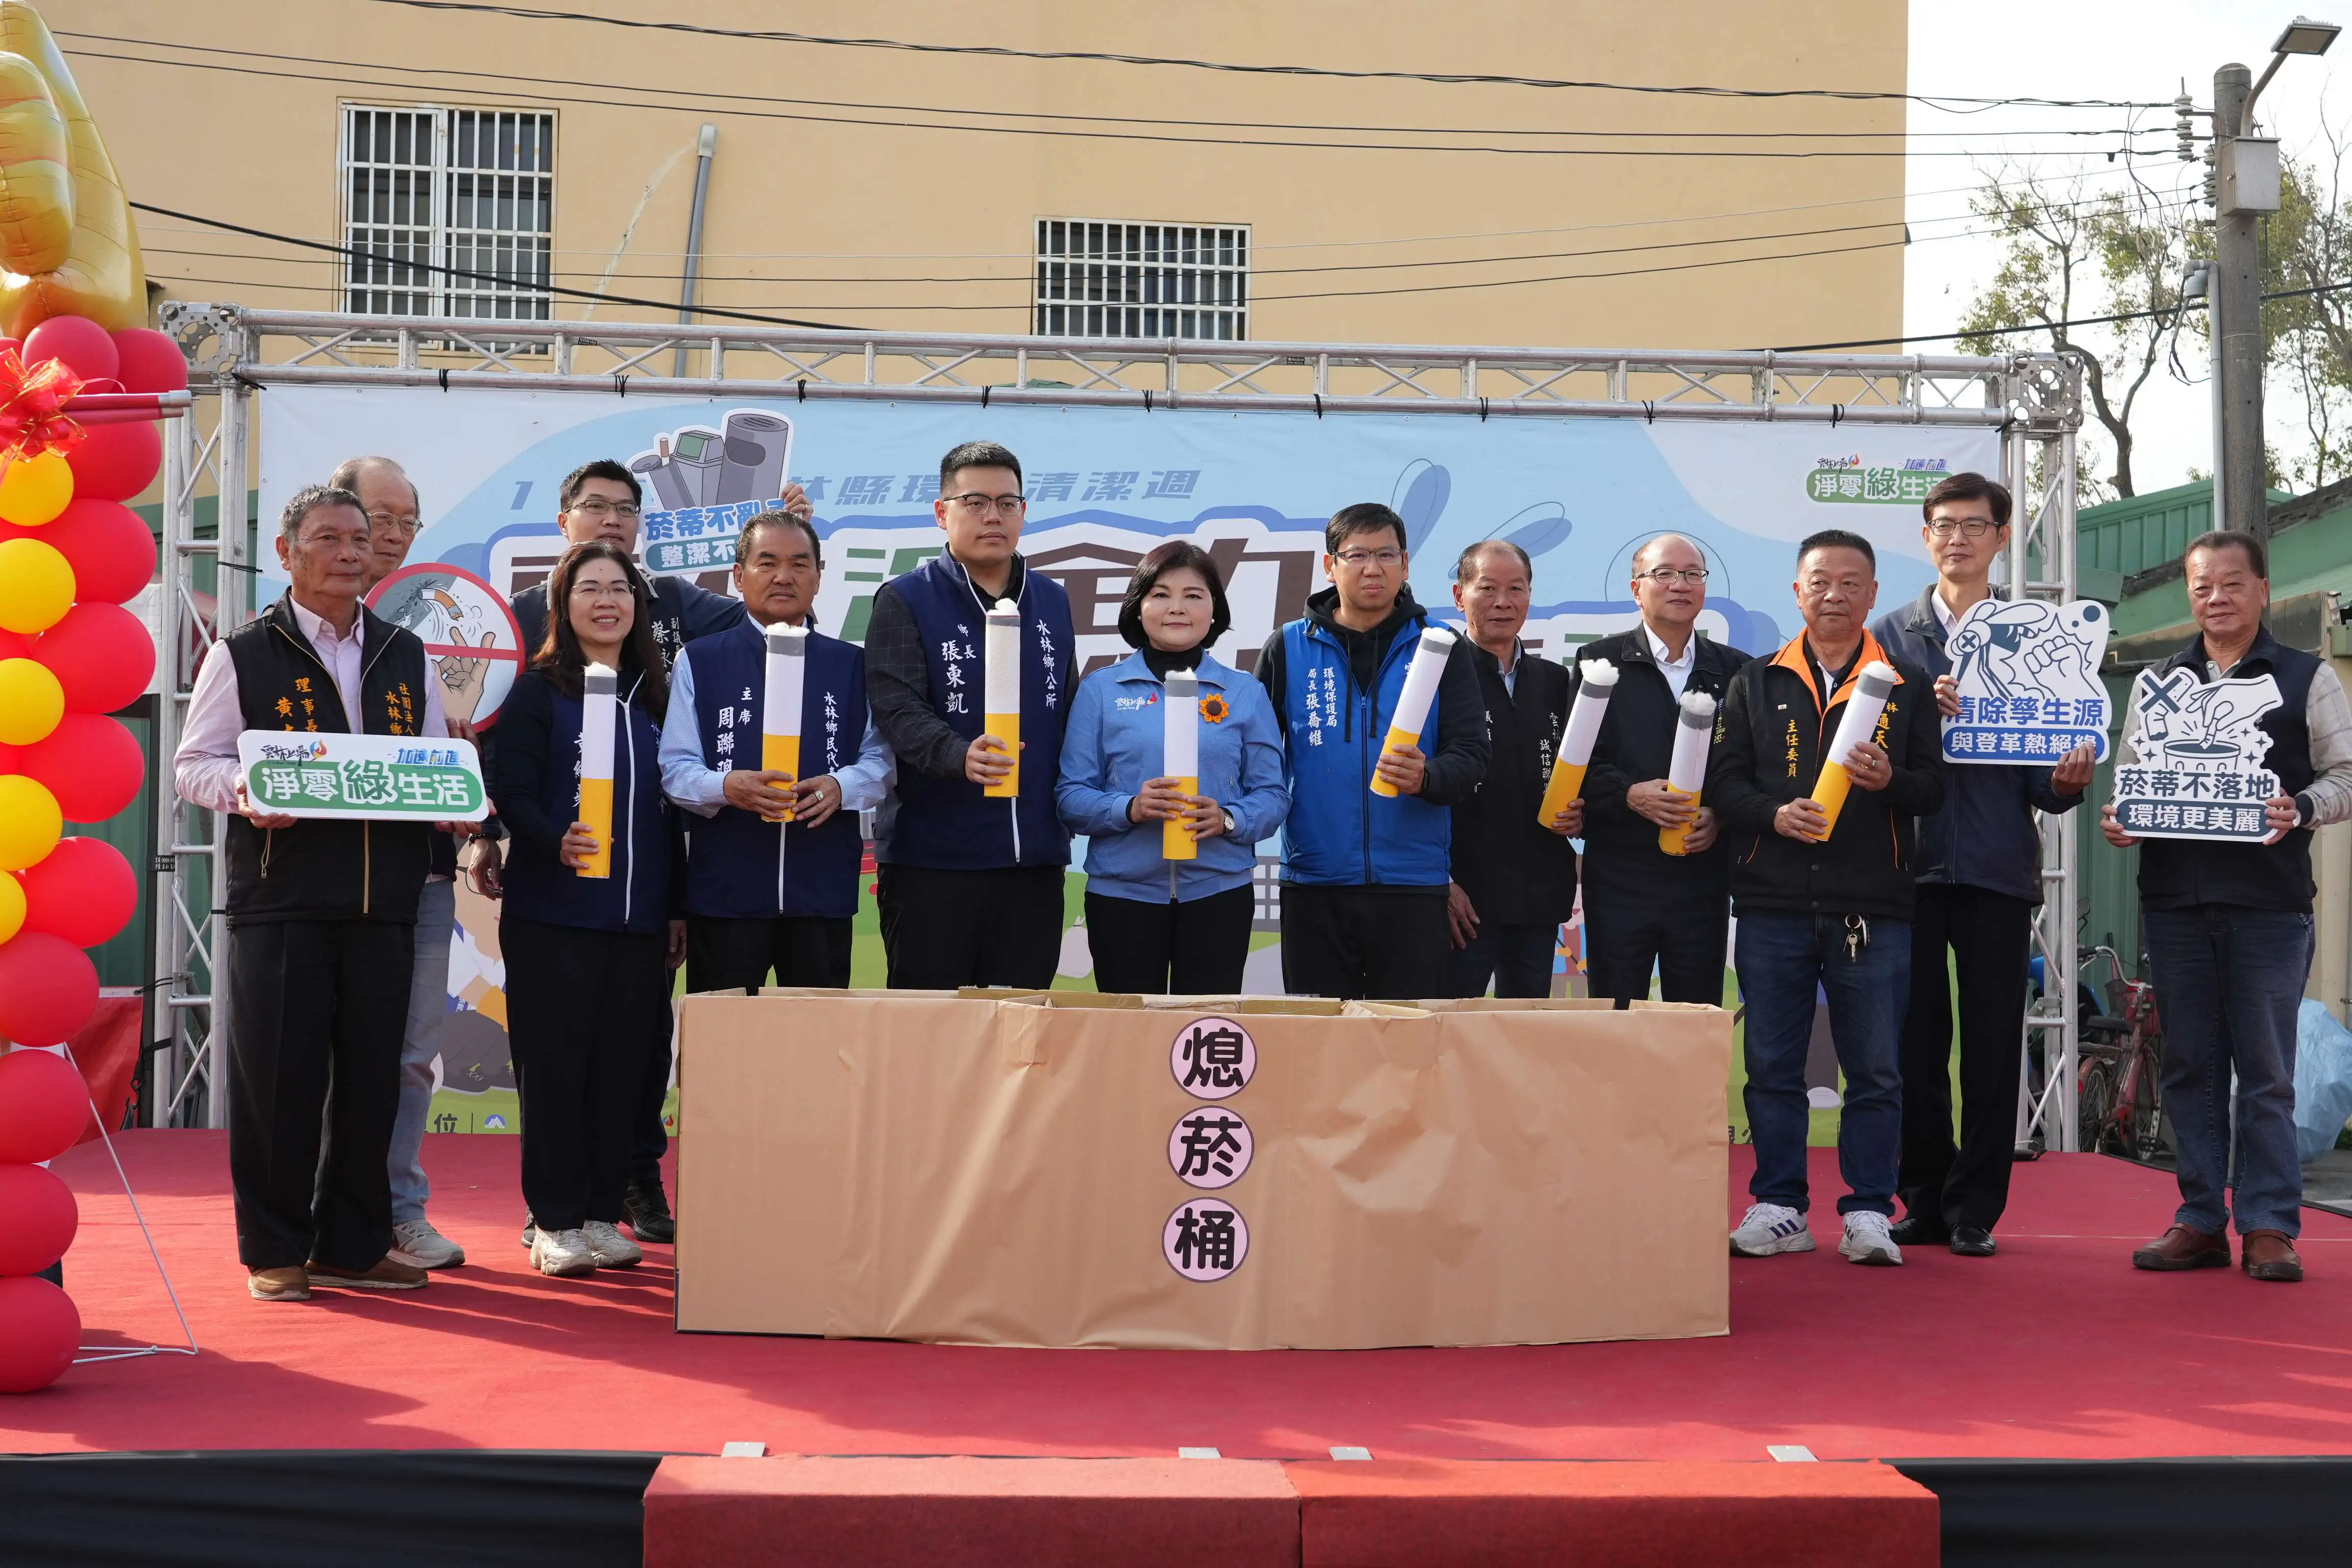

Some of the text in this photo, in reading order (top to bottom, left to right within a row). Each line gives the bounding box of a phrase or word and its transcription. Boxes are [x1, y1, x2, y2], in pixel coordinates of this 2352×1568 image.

[941, 640, 968, 714] 張東凱
[1037, 619, 1057, 710] 水林鄉公所
[295, 677, 318, 732] 理事長
[738, 687, 752, 725] 主席
[1324, 667, 1337, 727] 環境保護局
[1785, 719, 1799, 777] 主任委員
[1875, 713, 1891, 753] 通天
[398, 748, 459, 766] 加速前進
[261, 759, 470, 806] 淨零綠生活
[2119, 768, 2274, 801] 菸蒂不落地
[2128, 804, 2261, 832] 環境更美麗
